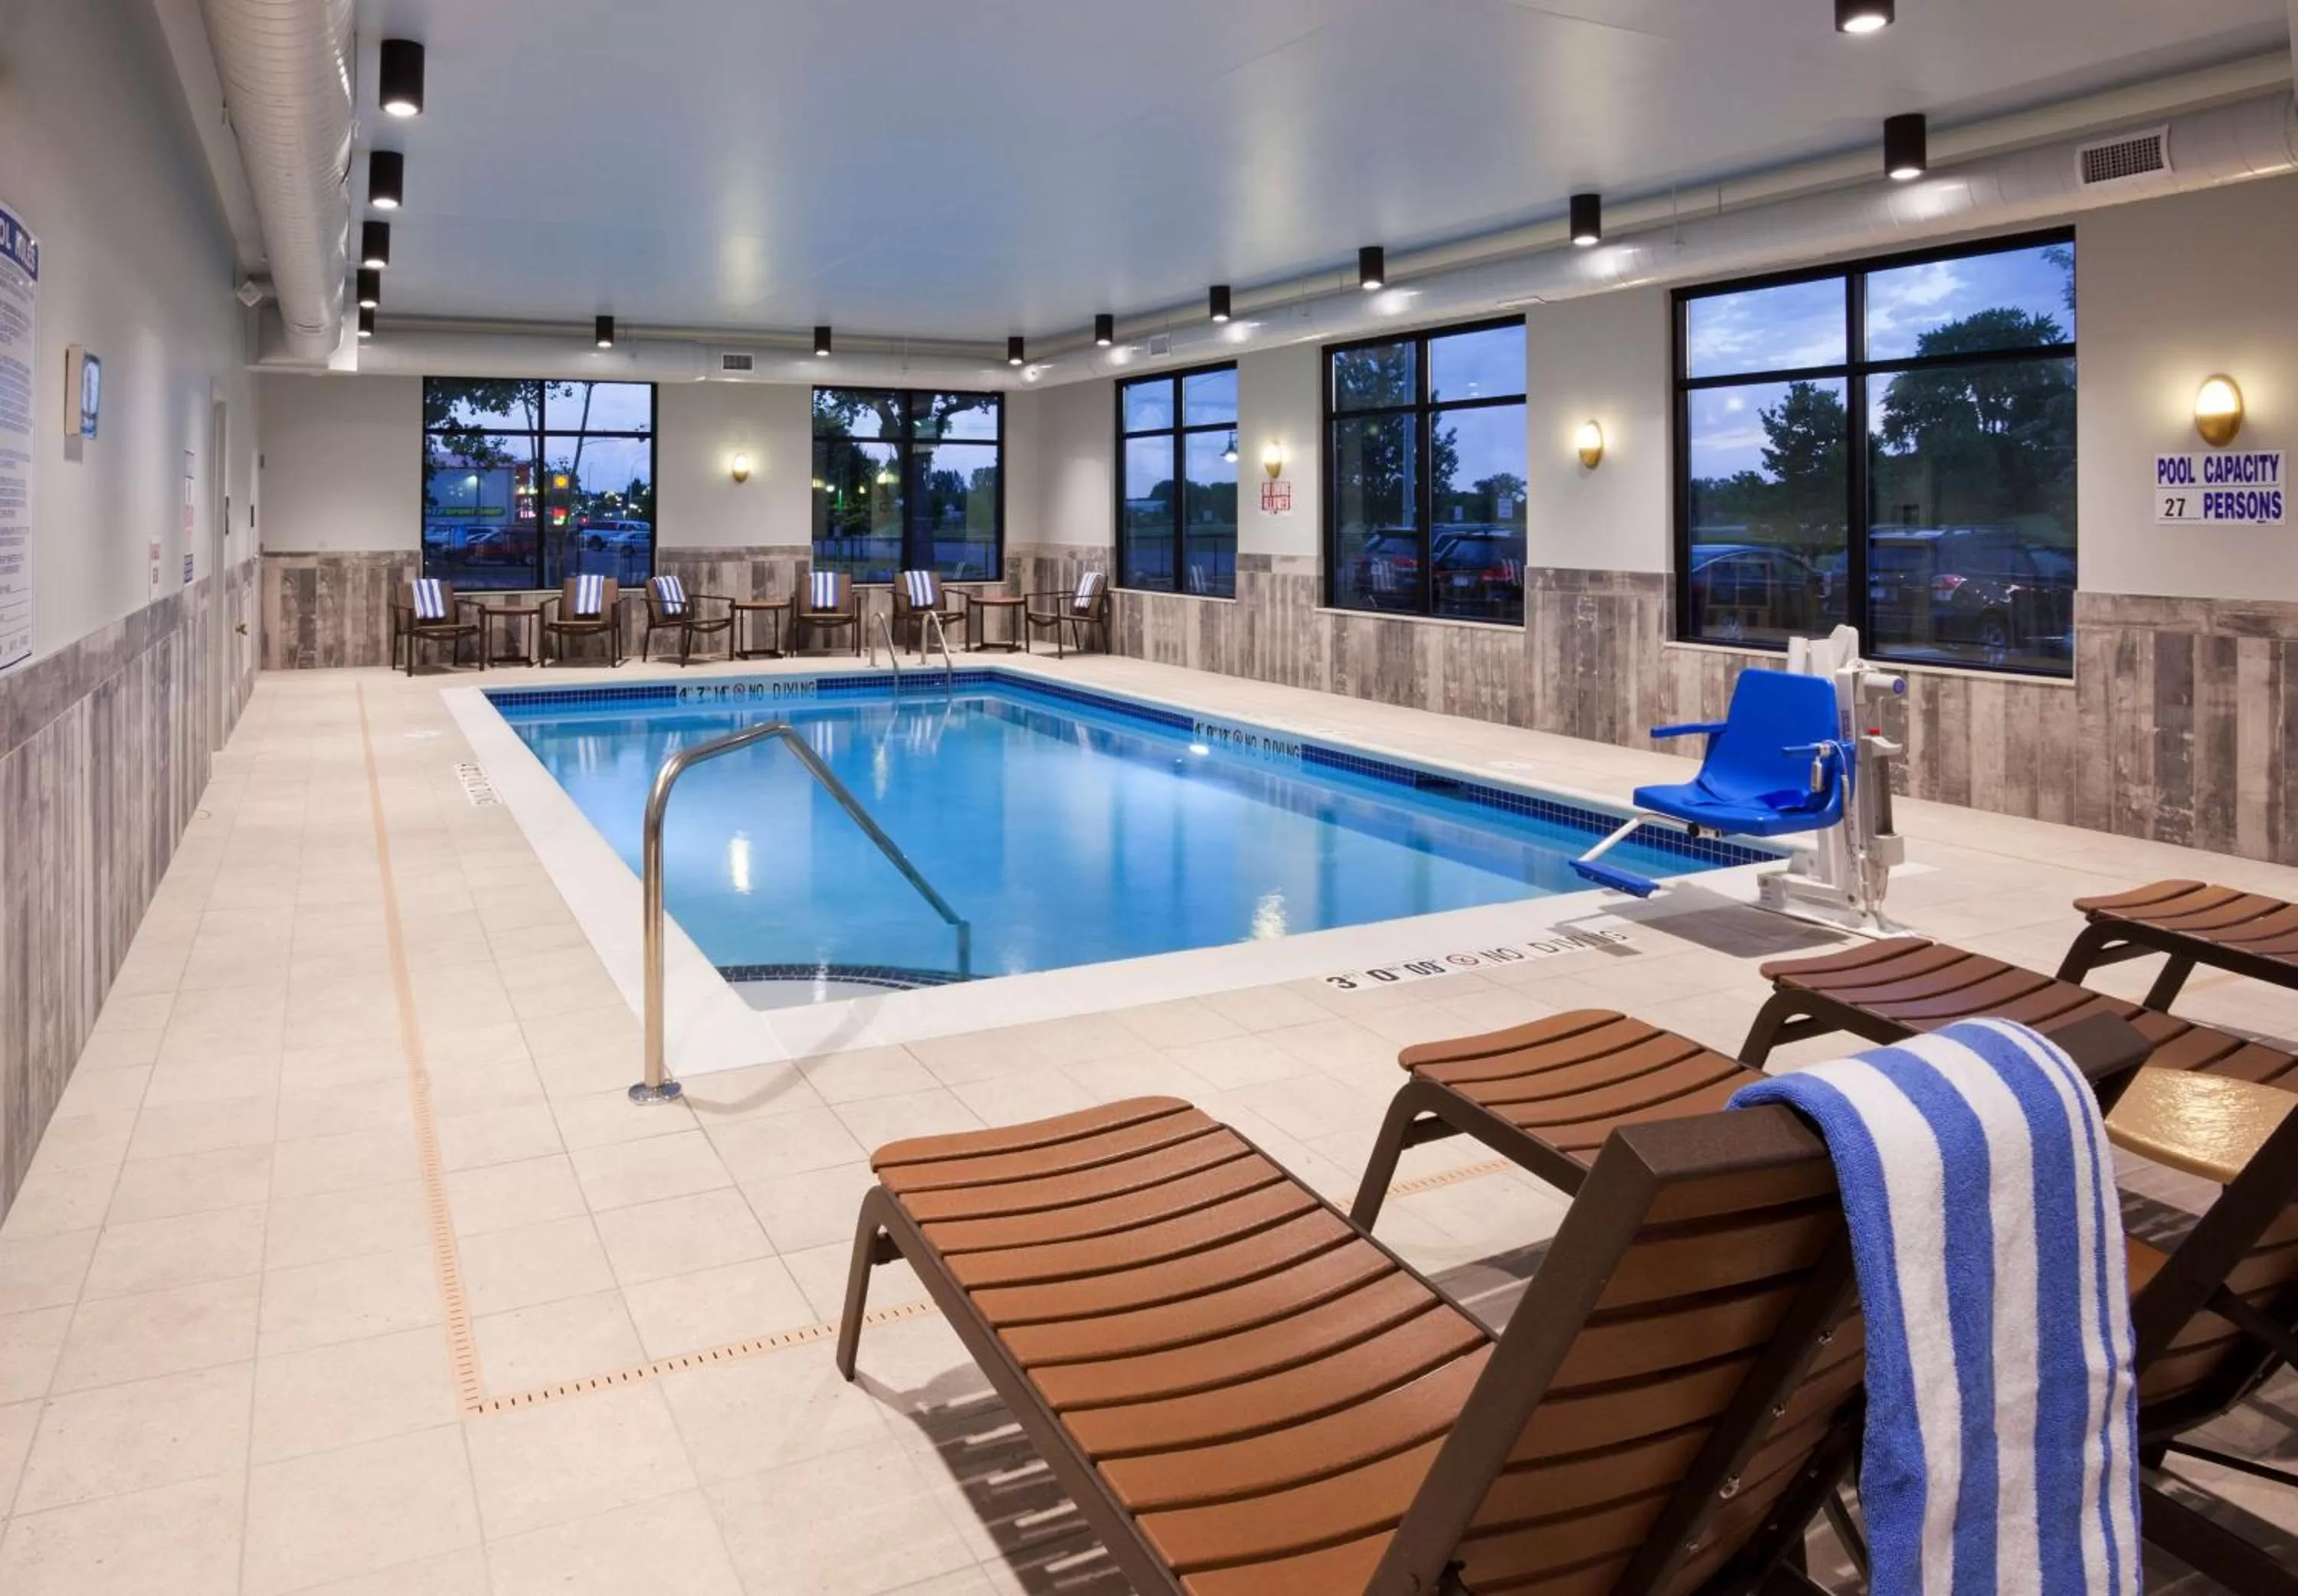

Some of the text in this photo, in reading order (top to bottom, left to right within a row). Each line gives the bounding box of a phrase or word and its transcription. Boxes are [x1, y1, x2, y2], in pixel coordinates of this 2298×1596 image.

[2158, 453, 2280, 484] POOL CAPACITY
[2165, 491, 2282, 520] 27 PERSONS
[749, 683, 764, 698] NO
[1478, 947, 1525, 963] NO
[1527, 930, 1628, 953] DIVING
